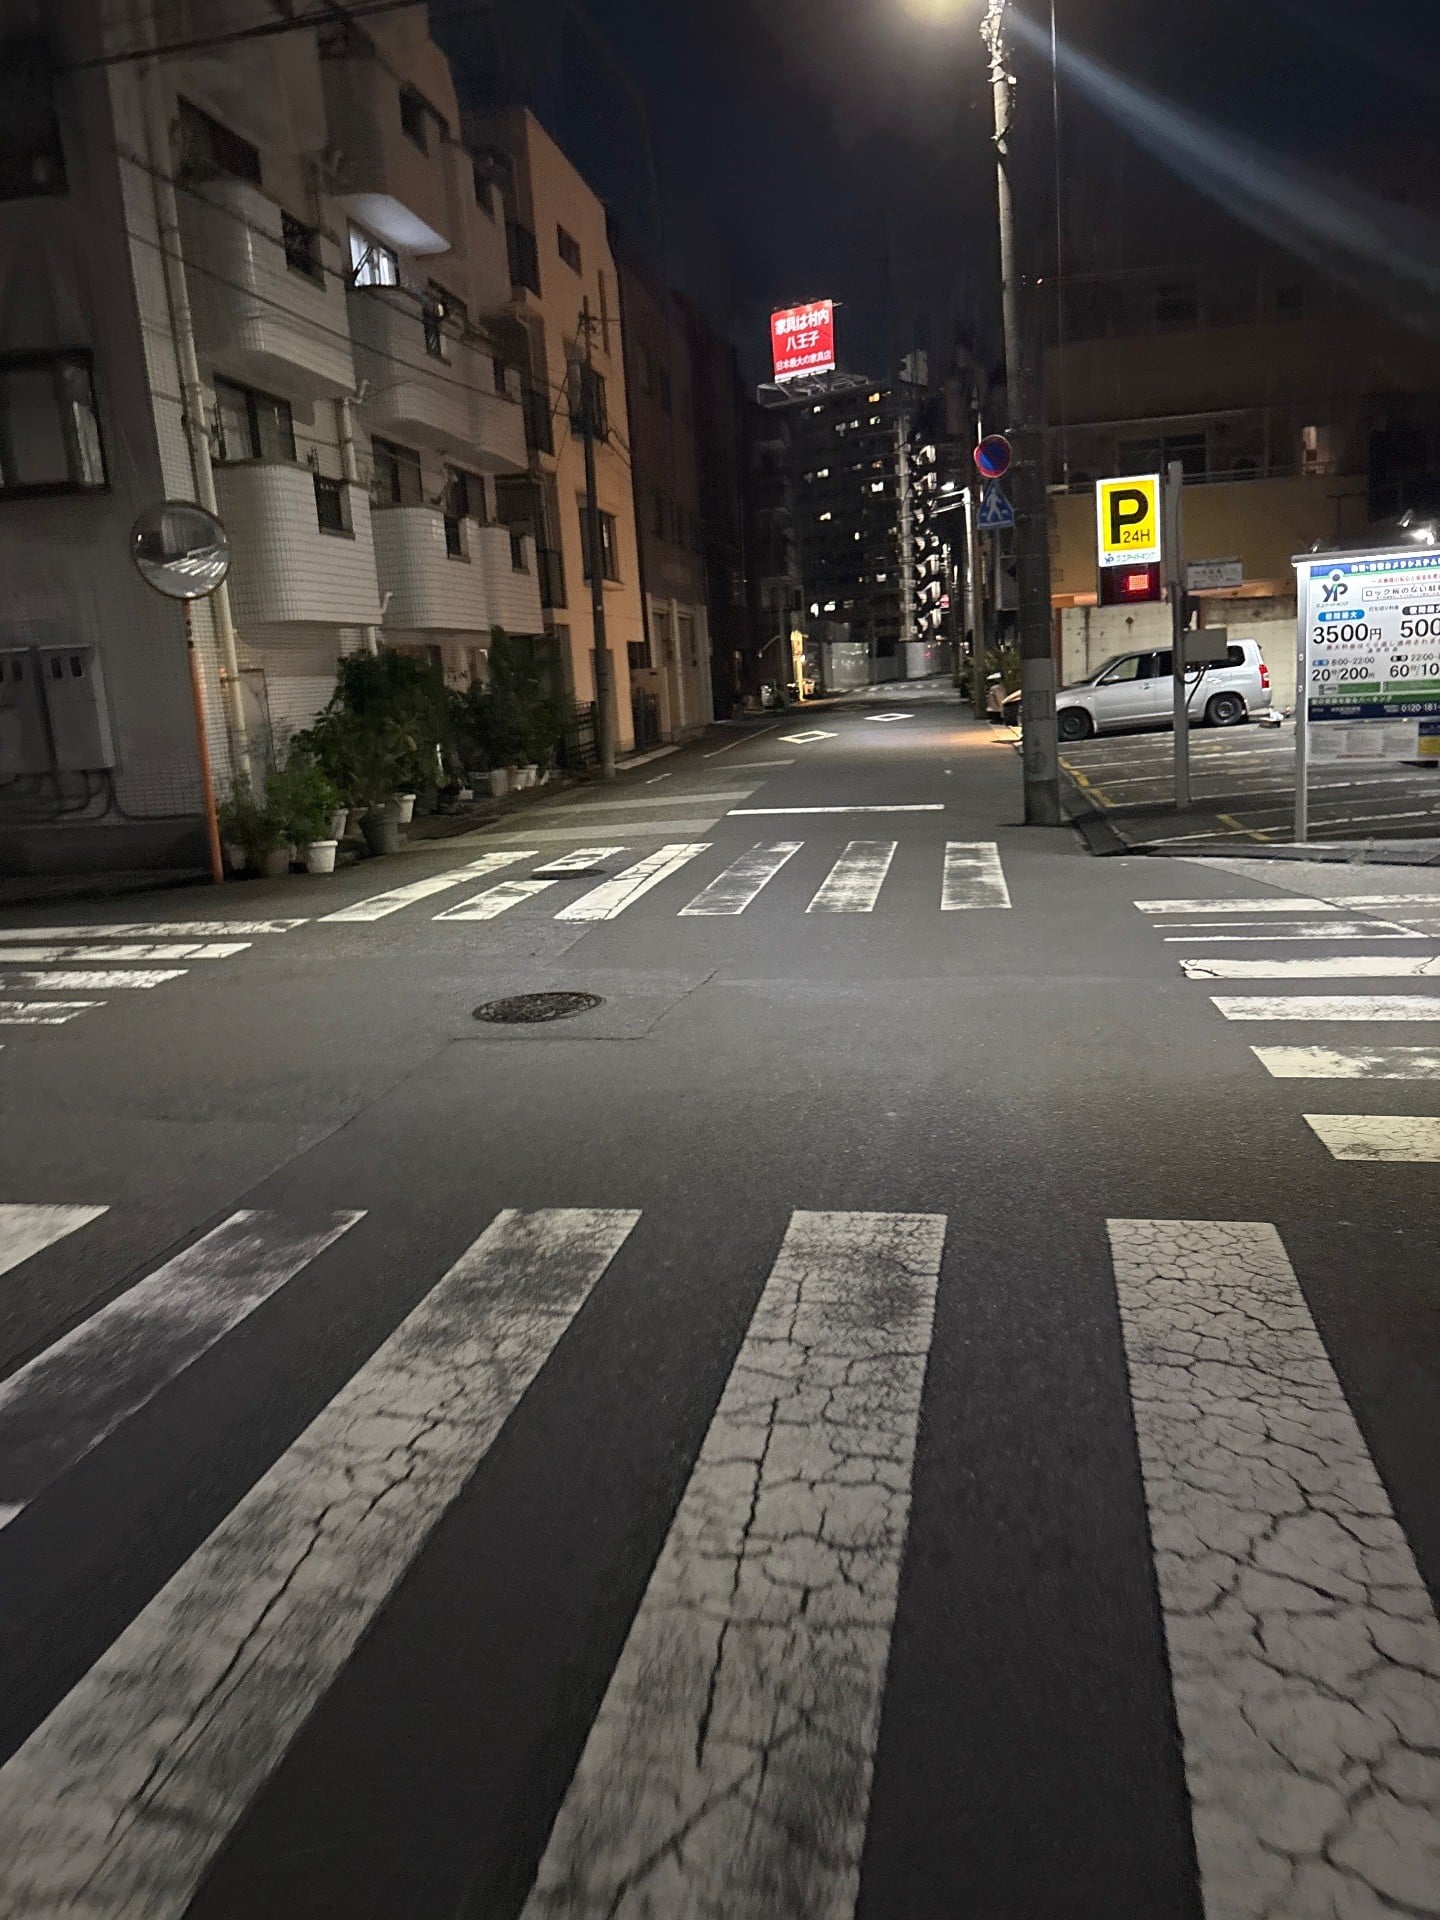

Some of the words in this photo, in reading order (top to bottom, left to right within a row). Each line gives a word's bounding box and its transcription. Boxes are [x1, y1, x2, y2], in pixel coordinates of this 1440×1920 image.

[786, 330, 820, 352] 八王子
[1110, 489, 1149, 544] P
[1123, 529, 1150, 543] 24H
[1365, 583, 1440, 597] ロック板のない駐
[1313, 623, 1381, 644] 3500円
[1400, 618, 1440, 638] 500
